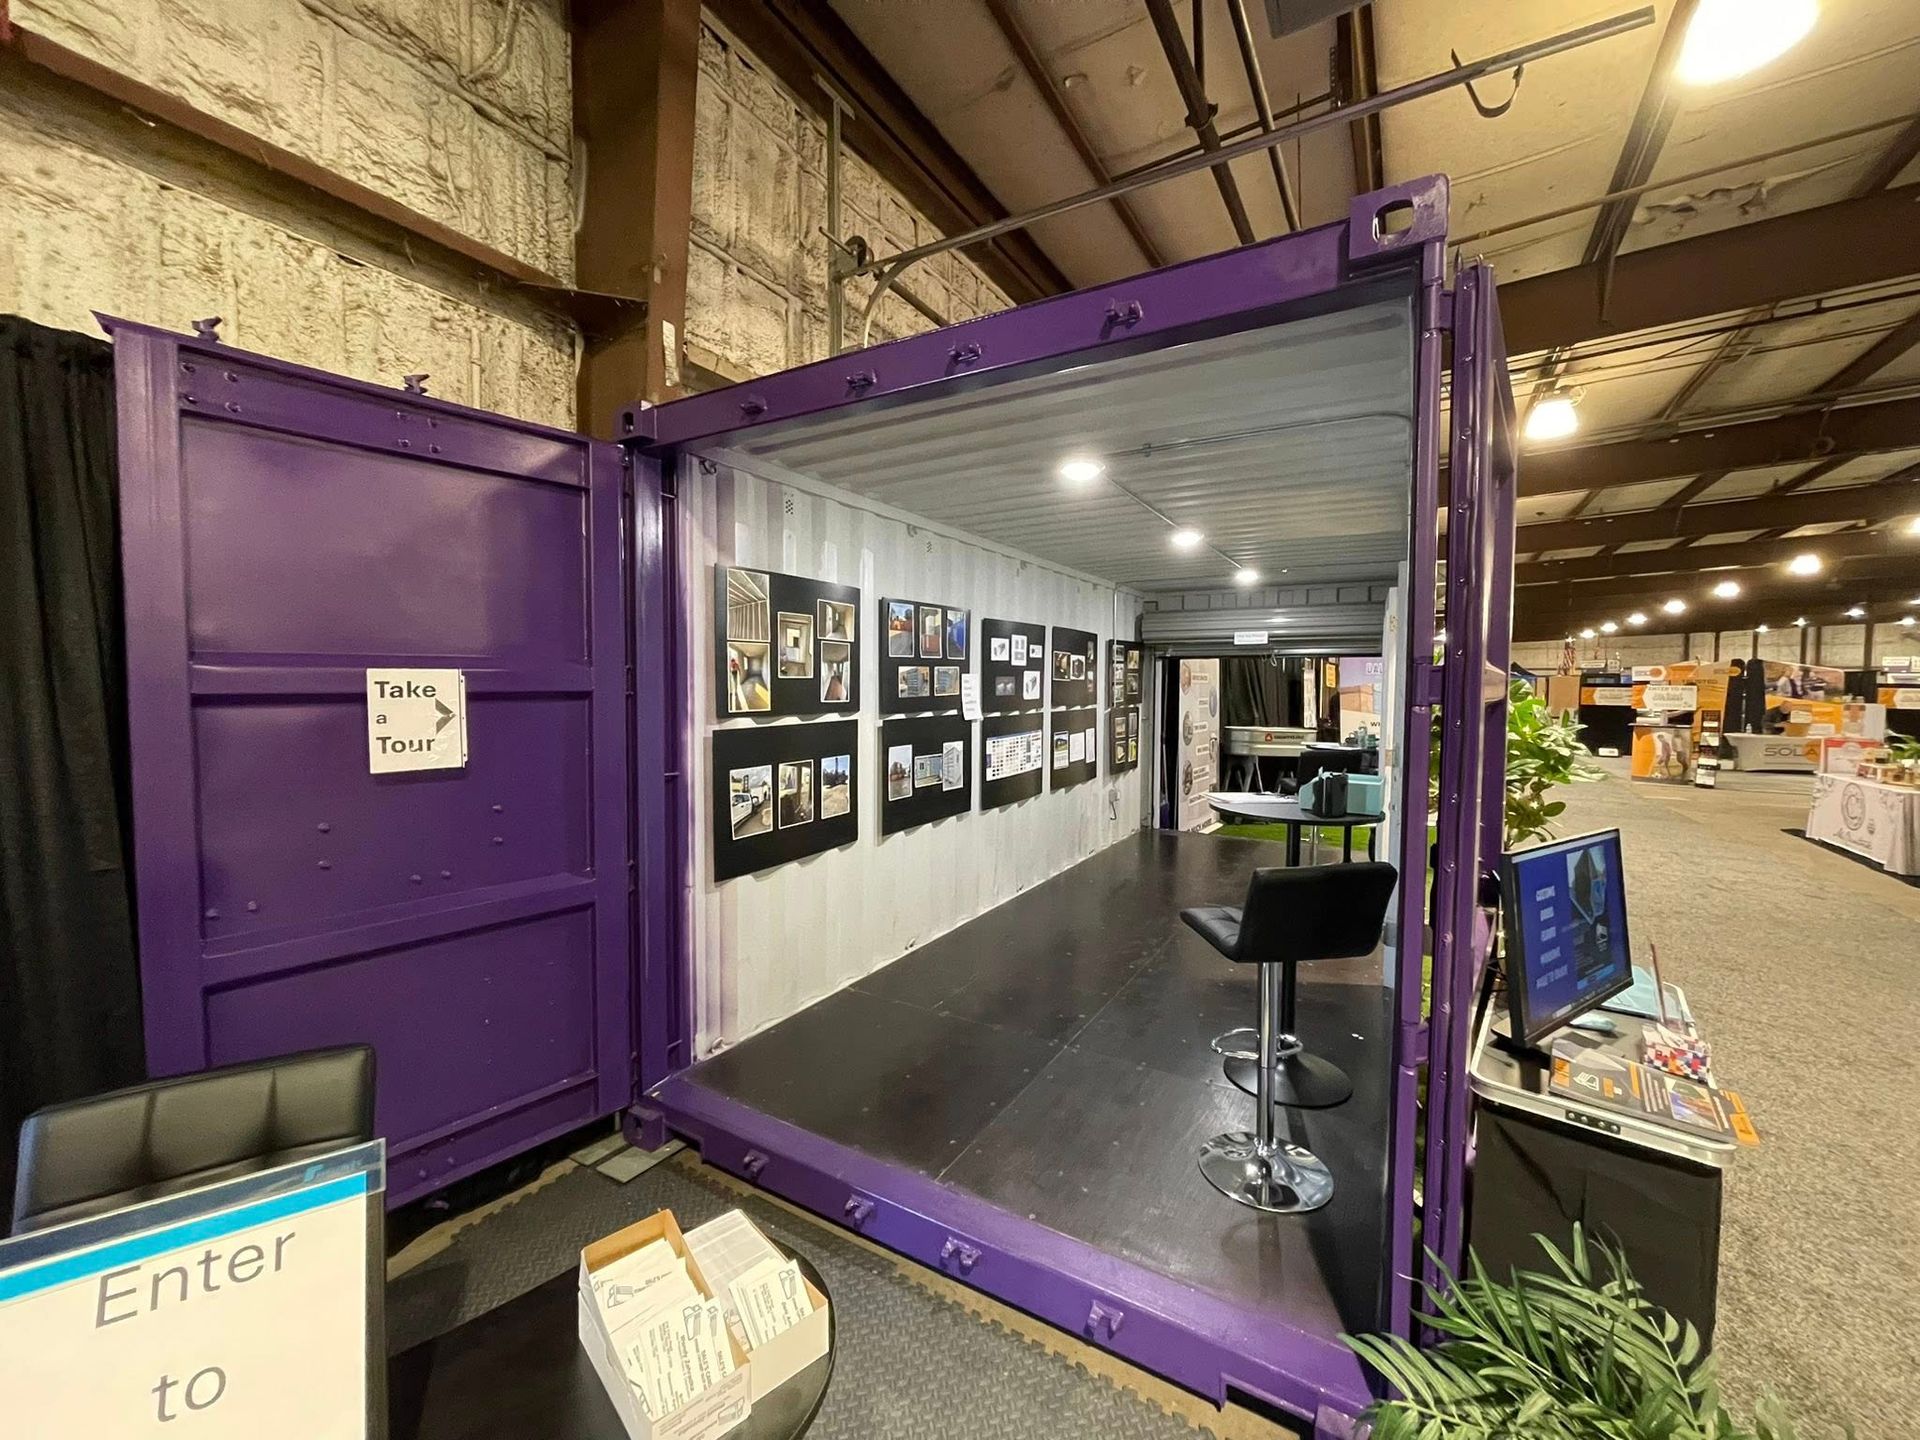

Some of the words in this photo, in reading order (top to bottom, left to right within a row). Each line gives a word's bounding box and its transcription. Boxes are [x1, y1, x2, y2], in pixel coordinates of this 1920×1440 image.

[374, 681, 437, 699] Take
[376, 713, 388, 724] a
[376, 736, 435, 754] Tour
[96, 1232, 295, 1328] Enter
[152, 1366, 226, 1422] to
